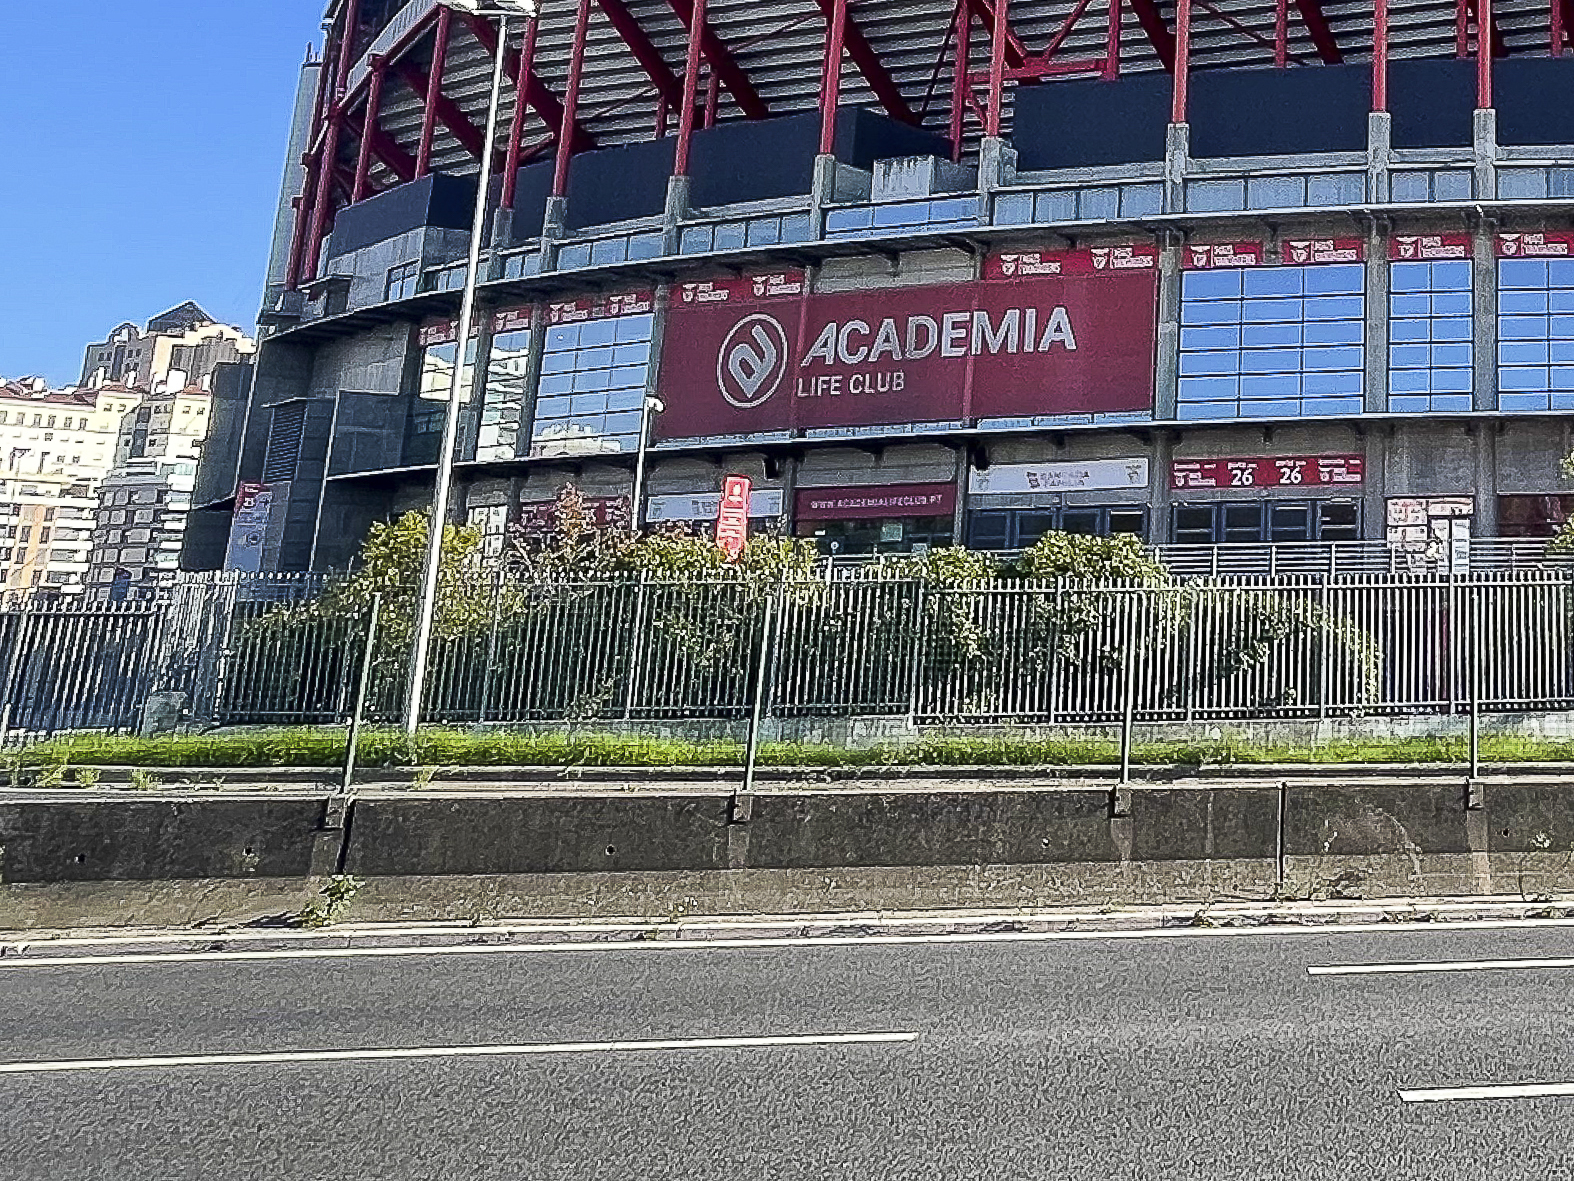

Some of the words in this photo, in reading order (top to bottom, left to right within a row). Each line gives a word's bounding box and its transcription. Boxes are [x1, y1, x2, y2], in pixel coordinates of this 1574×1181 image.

[800, 307, 1077, 367] ACADEMIA
[797, 375, 843, 397] LIFE
[849, 372, 905, 394] CLUB
[1231, 469, 1253, 485] 26
[1279, 467, 1301, 484] 26
